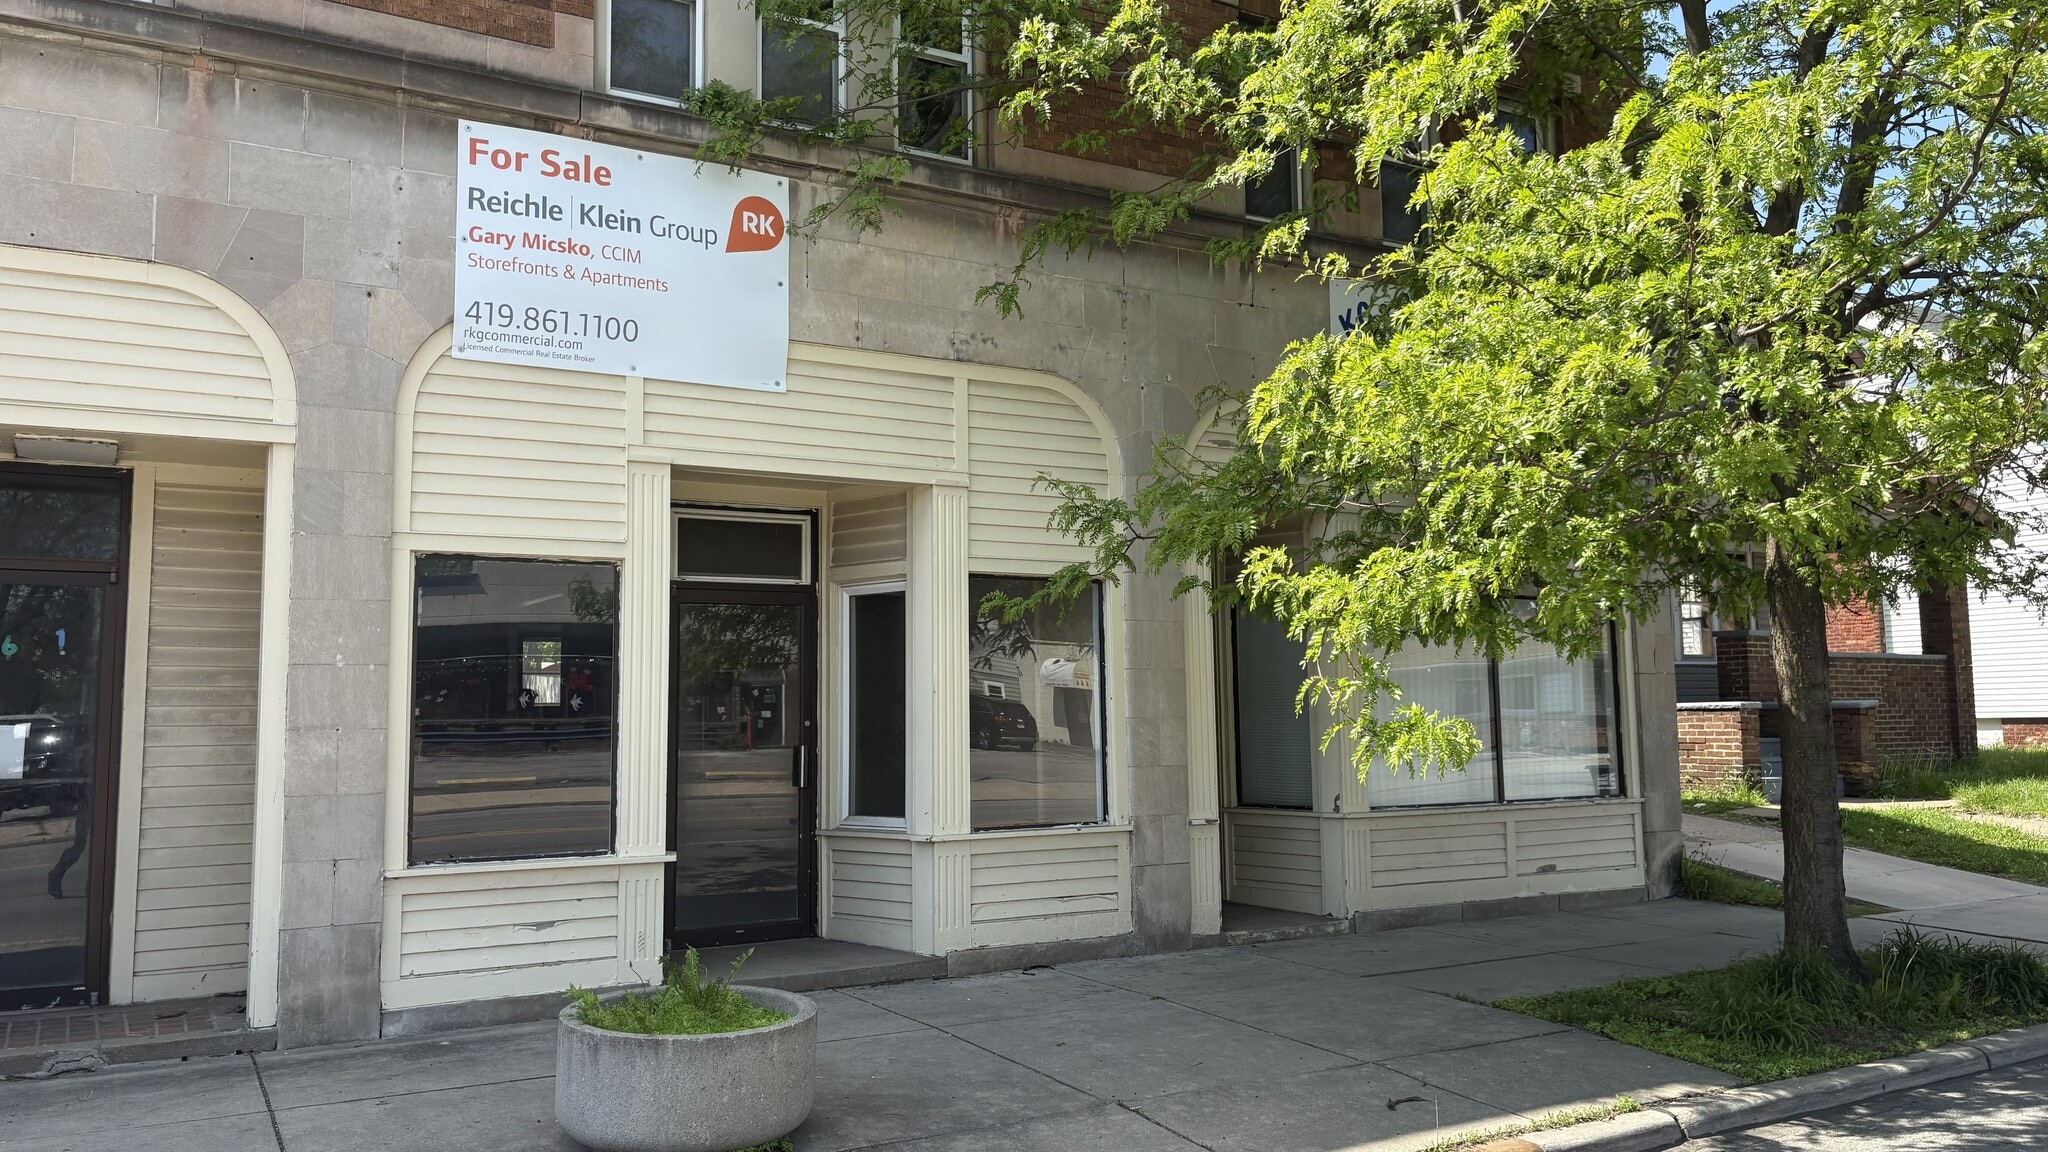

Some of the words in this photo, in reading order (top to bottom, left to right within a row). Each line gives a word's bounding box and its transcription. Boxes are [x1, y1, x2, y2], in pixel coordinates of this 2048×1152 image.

[469, 137, 529, 172] For
[540, 149, 612, 186] Sale
[468, 186, 563, 221] Reichle
[580, 203, 641, 233] Klein
[650, 215, 717, 250] Group
[742, 211, 776, 238] RK
[468, 226, 516, 250] Gary
[522, 232, 595, 259] Micsko,
[601, 245, 641, 264] CCIM
[468, 253, 558, 278] Storefronts
[563, 265, 576, 280] &
[580, 267, 668, 292] Apartments
[463, 326, 583, 350] rkgcommercial.com
[464, 301, 639, 342] 419.861.1100
[463, 343, 493, 352] Licensed
[495, 346, 534, 356] Commercial
[535, 351, 550, 359] Real
[552, 353, 572, 361] Estate
[574, 355, 595, 363] Broker
